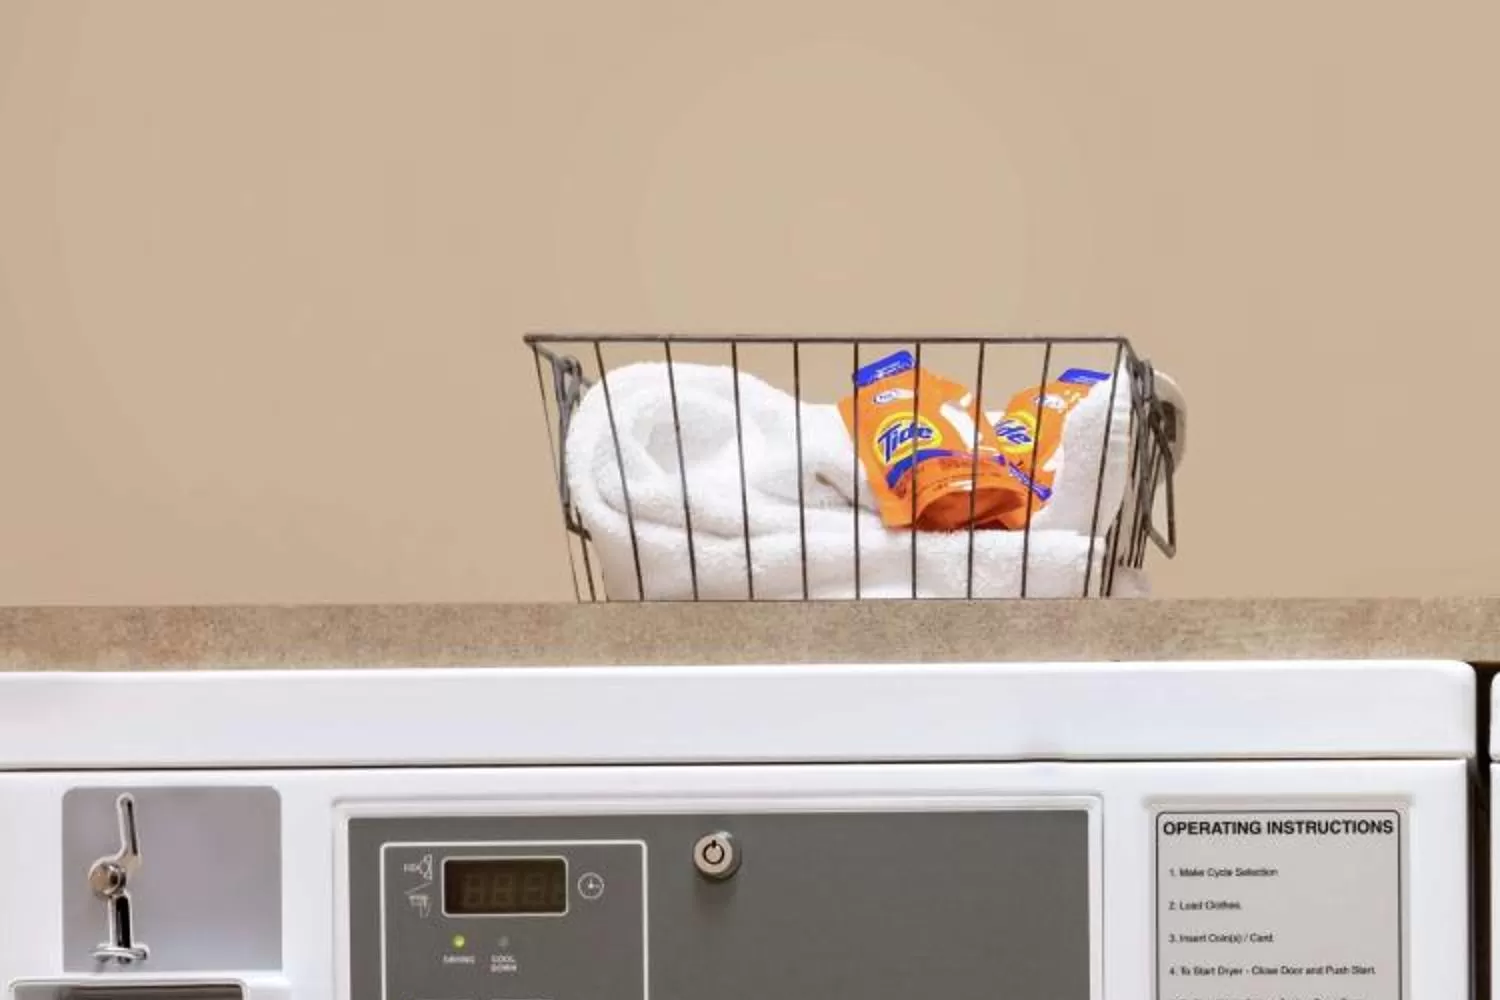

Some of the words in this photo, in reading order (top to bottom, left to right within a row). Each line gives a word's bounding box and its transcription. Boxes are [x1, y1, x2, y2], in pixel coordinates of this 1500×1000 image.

[877, 422, 933, 463] Tide
[1163, 821, 1262, 836] OPERATING
[1267, 819, 1394, 835] INSTRUCTIONS
[1179, 868, 1205, 877] Make
[1207, 867, 1233, 879] Cycle
[1179, 901, 1203, 911] Load
[1179, 934, 1206, 943] Insert
[1181, 966, 1191, 976] To
[1193, 966, 1216, 976] Start
[1217, 966, 1244, 978] Dryer
[1251, 965, 1278, 975] Close
[1280, 965, 1304, 975] Door
[1305, 966, 1324, 975] and
[1325, 965, 1349, 975] Push
